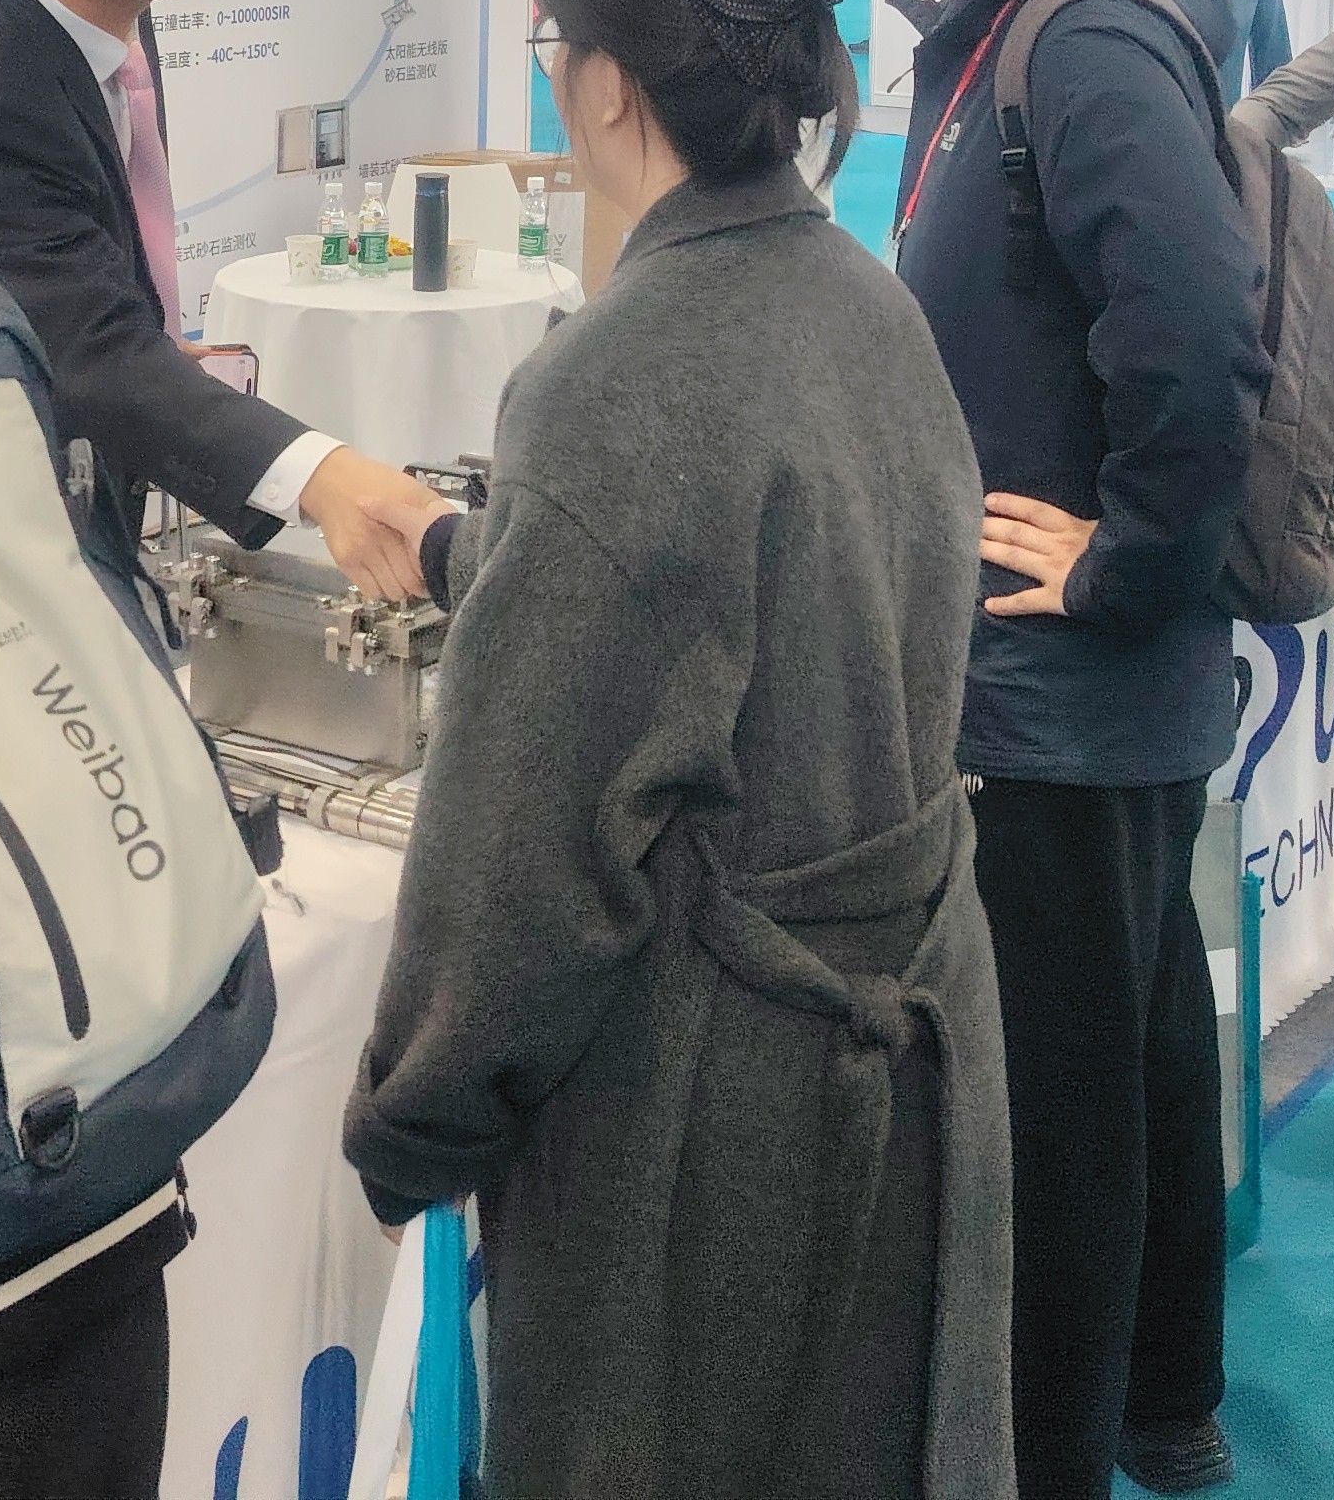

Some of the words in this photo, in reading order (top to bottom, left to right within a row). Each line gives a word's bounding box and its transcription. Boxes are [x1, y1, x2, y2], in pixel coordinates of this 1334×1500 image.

[385, 40, 449, 61] 太阳能无线版
[384, 63, 438, 83] 砂石监测仪
[32, 663, 167, 882] Weibao
